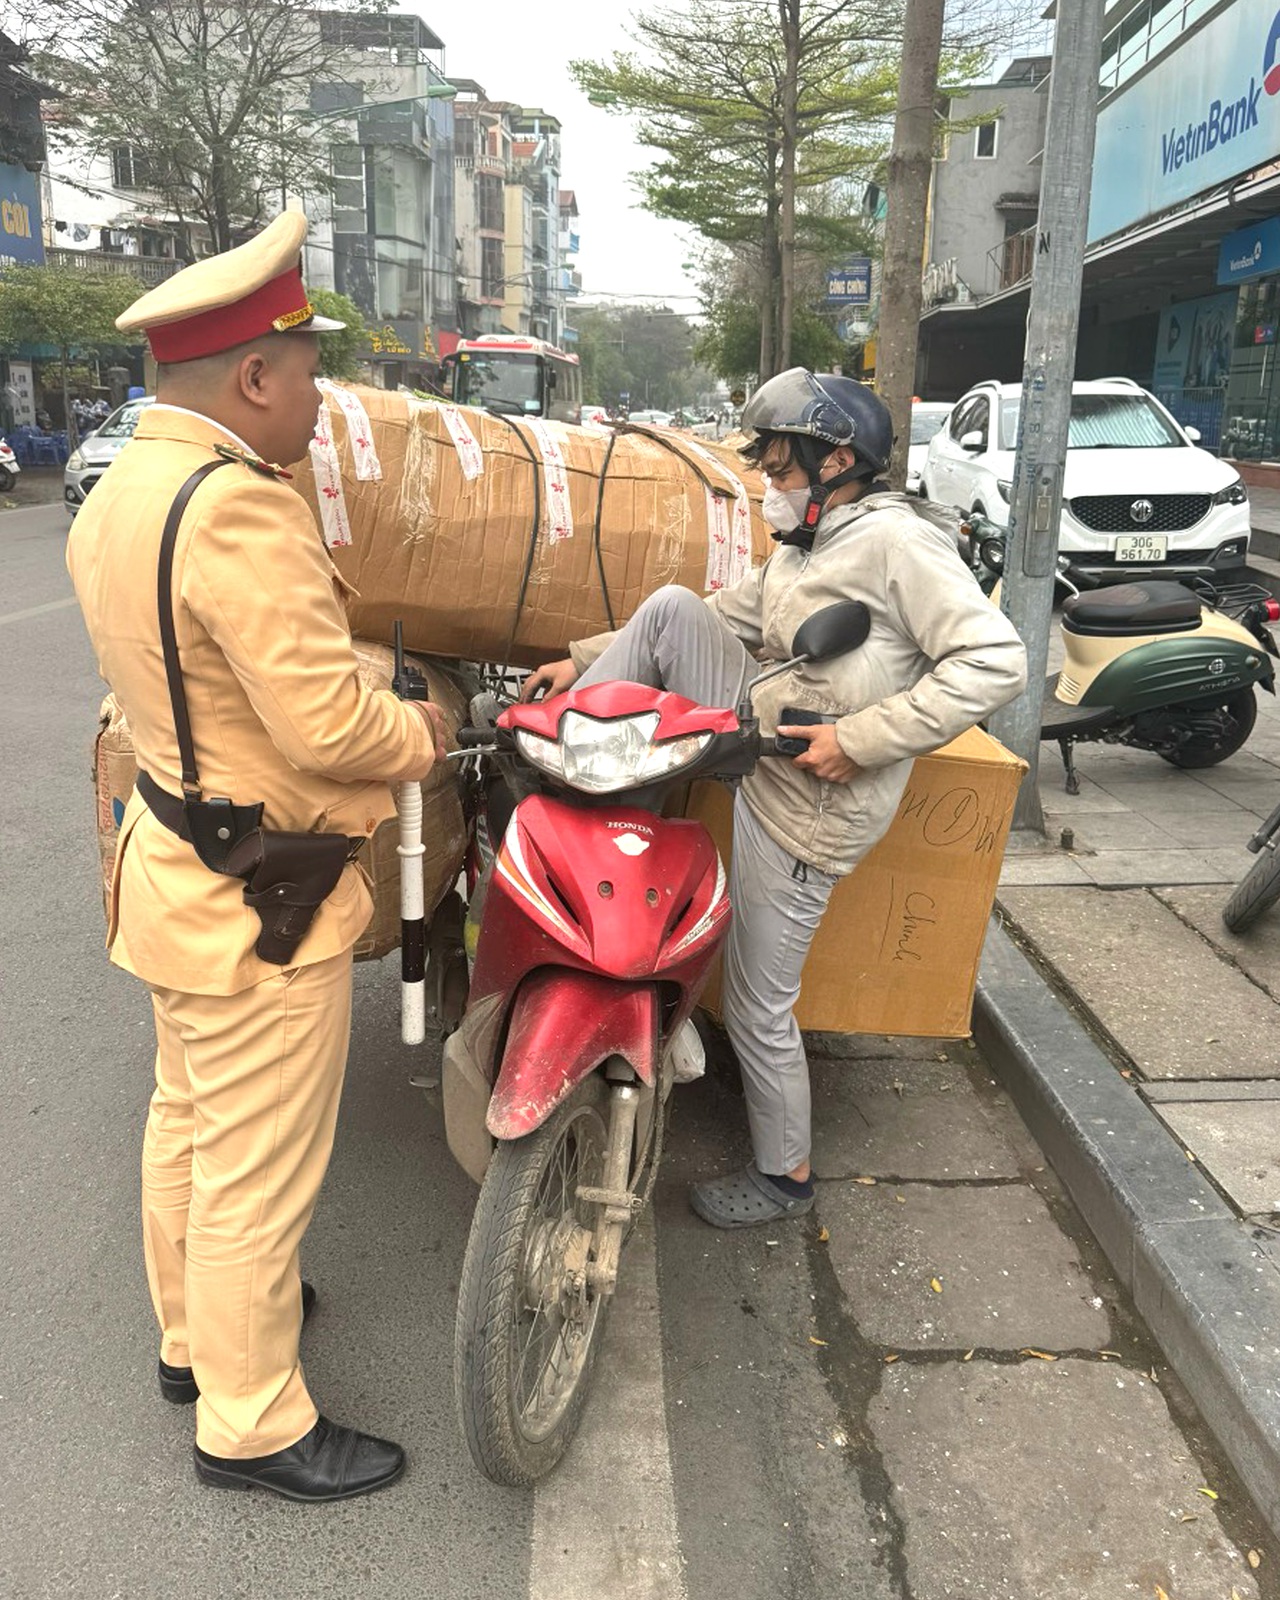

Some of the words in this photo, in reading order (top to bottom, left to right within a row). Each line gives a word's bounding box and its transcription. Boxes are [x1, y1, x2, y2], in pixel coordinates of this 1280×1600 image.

[1162, 76, 1262, 176] VietinBank
[1131, 537, 1153, 548] 30G
[1121, 549, 1161, 560] 561.70
[606, 821, 654, 836] HONDA
